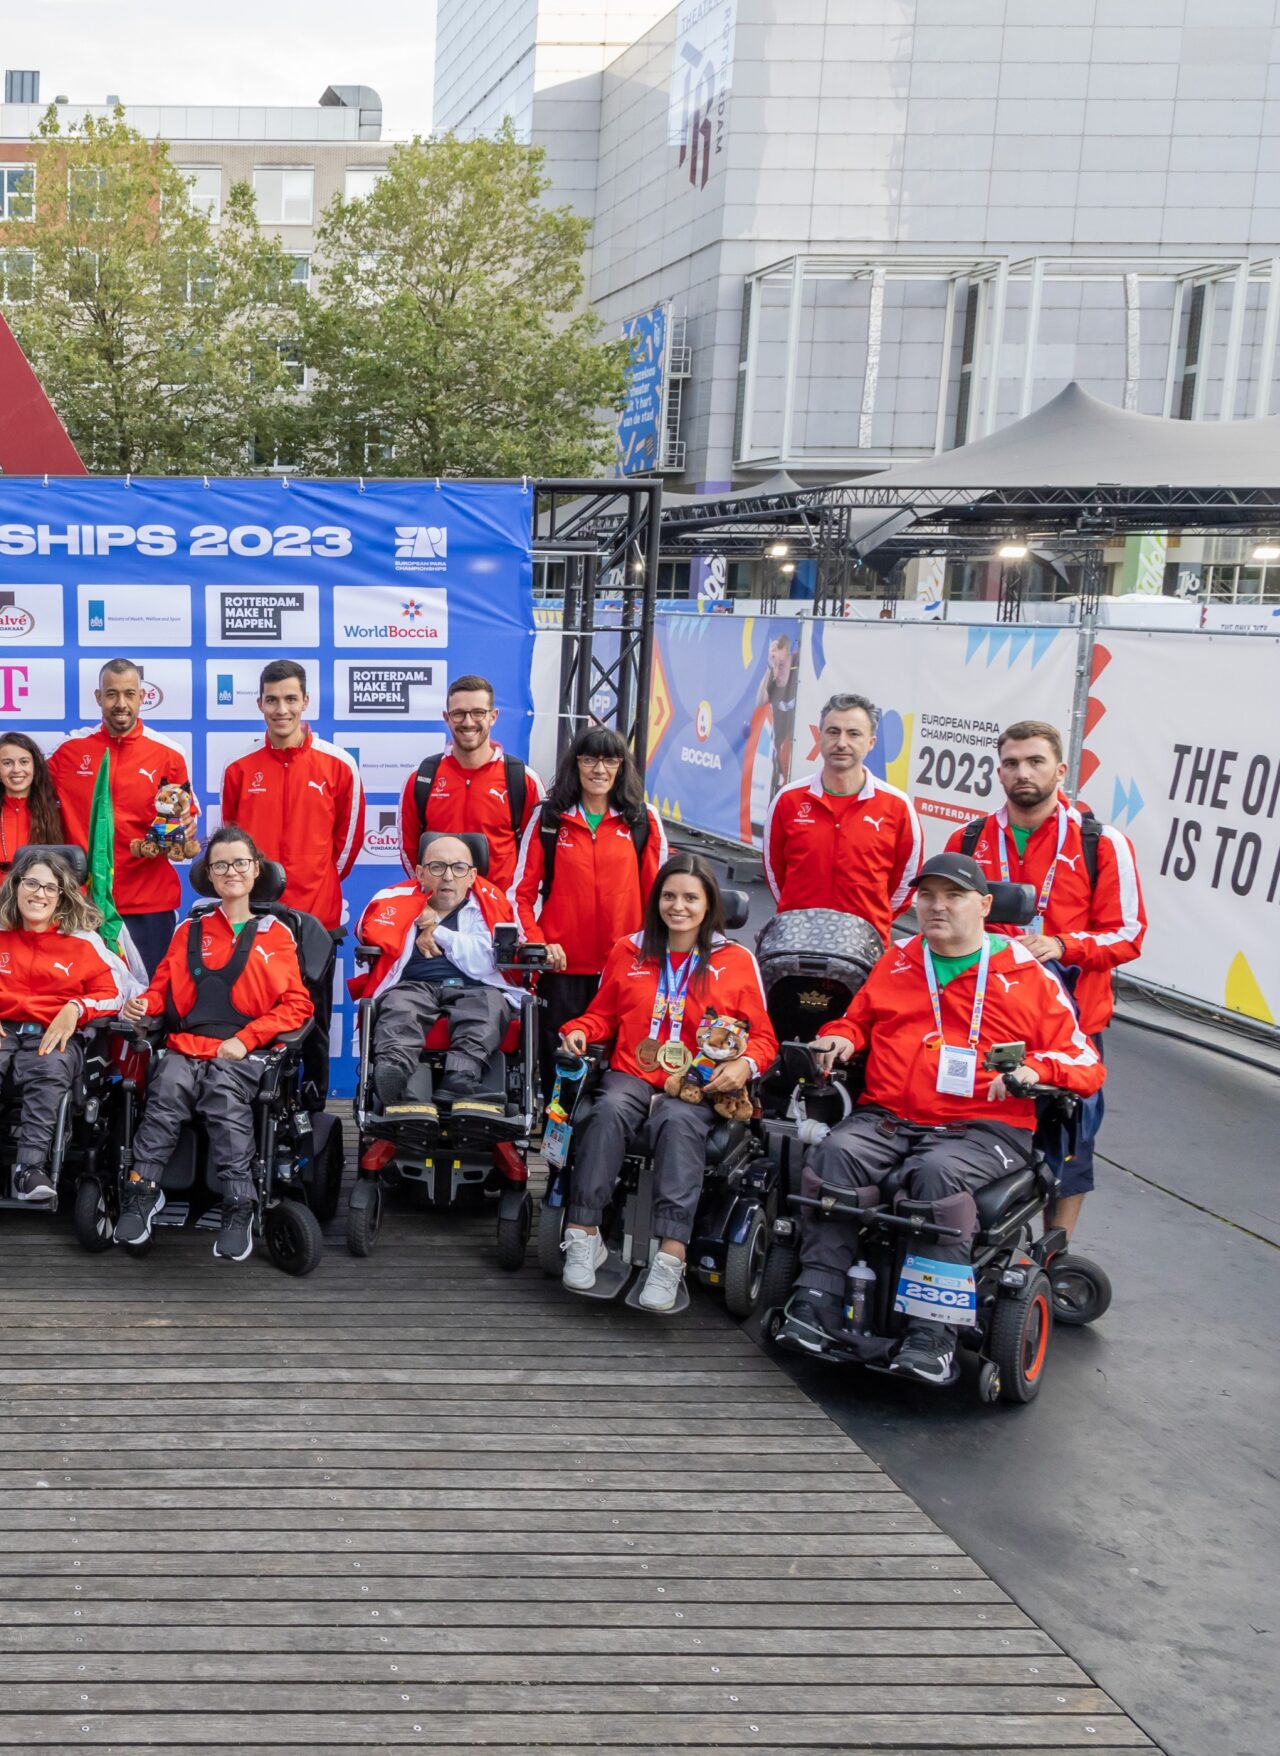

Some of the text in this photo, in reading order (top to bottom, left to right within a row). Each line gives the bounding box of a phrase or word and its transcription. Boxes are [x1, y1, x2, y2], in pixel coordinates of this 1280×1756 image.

[189, 525, 353, 558] 2023
[225, 596, 300, 607] ROTTERDAM.
[225, 607, 274, 618] MAKE IT
[225, 618, 277, 629] HAPPEN.
[344, 625, 438, 638] WorldBoccia
[353, 671, 428, 682] ROTTERDAM.
[353, 682, 402, 692] MAKE IT
[353, 692, 405, 703] HAPPEN.
[921, 714, 1000, 734] EUROPEAN PARA
[920, 728, 999, 749] CHAMPIONSHIPS
[681, 746, 722, 770] BOCCIA
[916, 746, 995, 797] 2023
[1169, 743, 1239, 810] THE
[921, 802, 980, 821] ROTTERDAM
[368, 835, 399, 846] Calv
[1160, 817, 1202, 882] IS
[1211, 826, 1262, 896] TO
[905, 1282, 970, 1307] 2302
